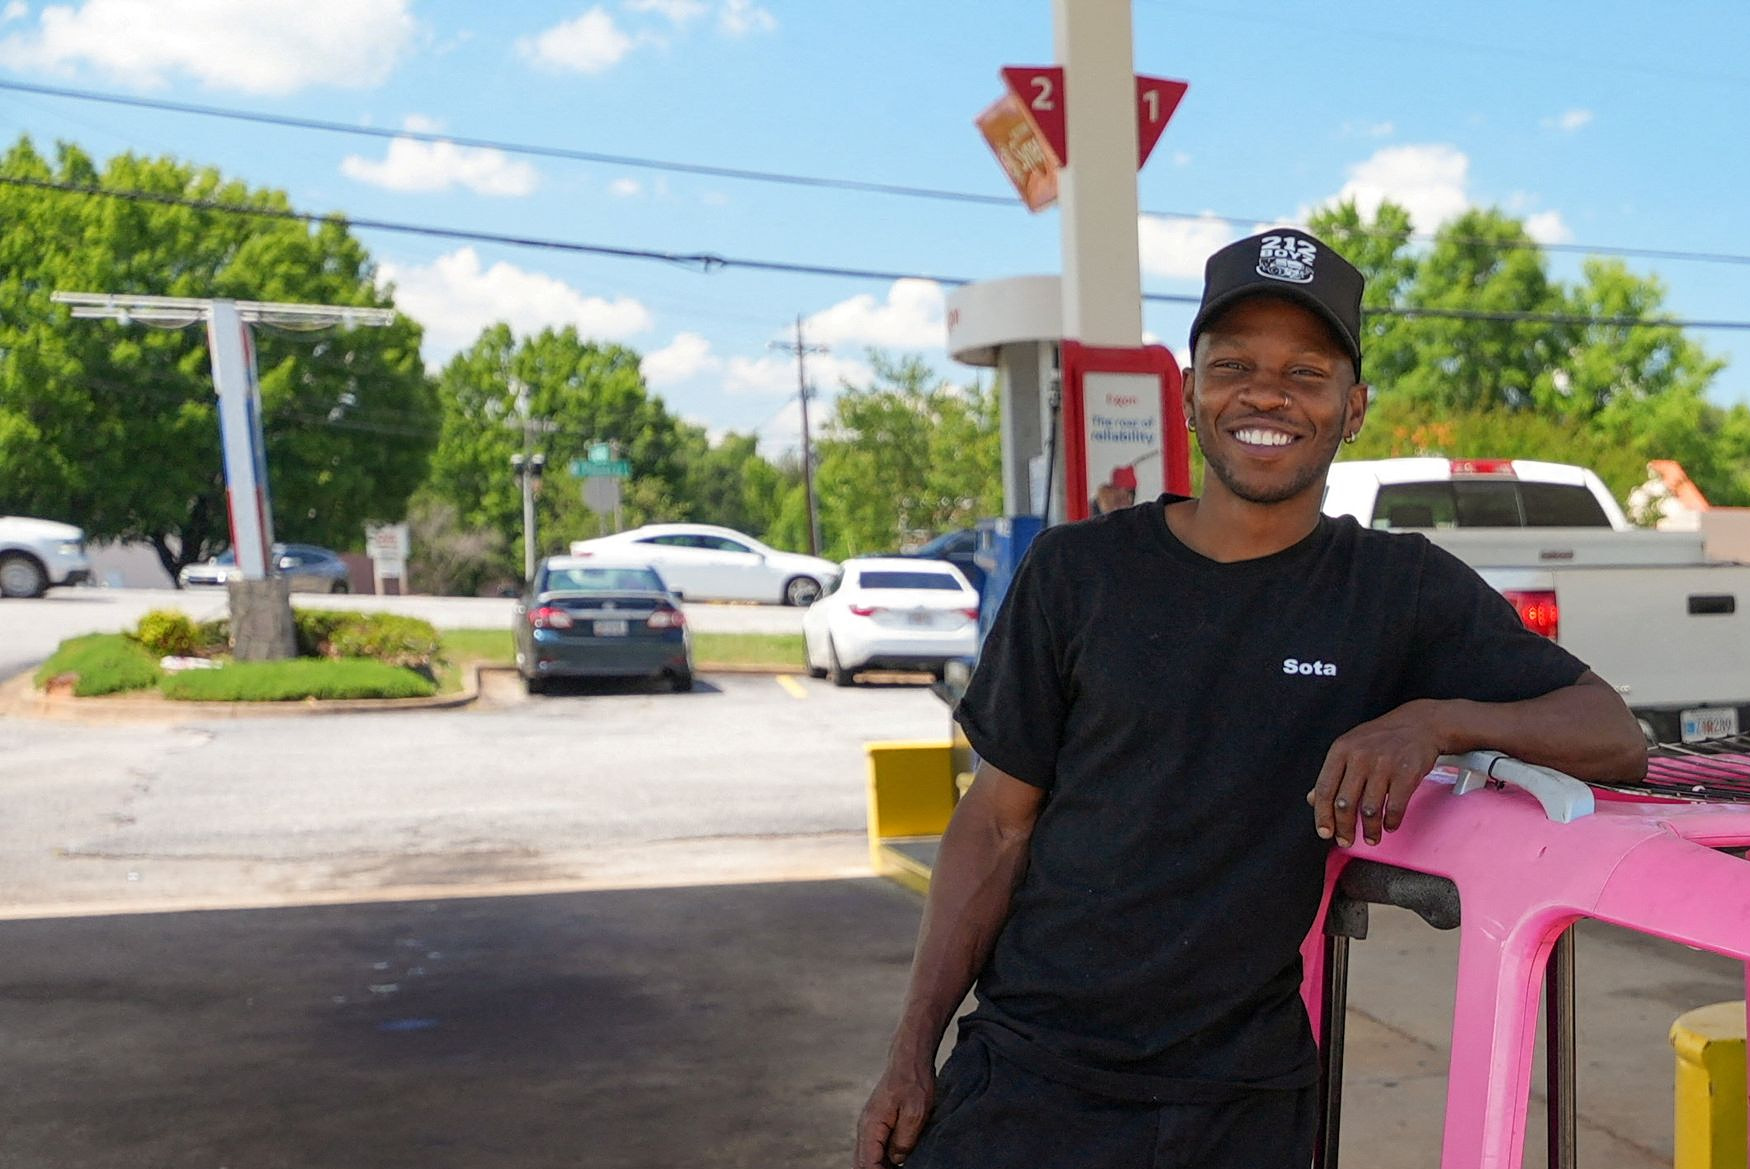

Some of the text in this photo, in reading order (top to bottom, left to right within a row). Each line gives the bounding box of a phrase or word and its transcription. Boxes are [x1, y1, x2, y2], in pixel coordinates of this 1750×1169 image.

[1030, 76, 1055, 111] 2
[1143, 90, 1160, 123] 1
[1261, 235, 1317, 255] 212
[1260, 249, 1316, 267] BOYZ
[1090, 430, 1153, 445] reliability
[1283, 658, 1337, 677] Sota
